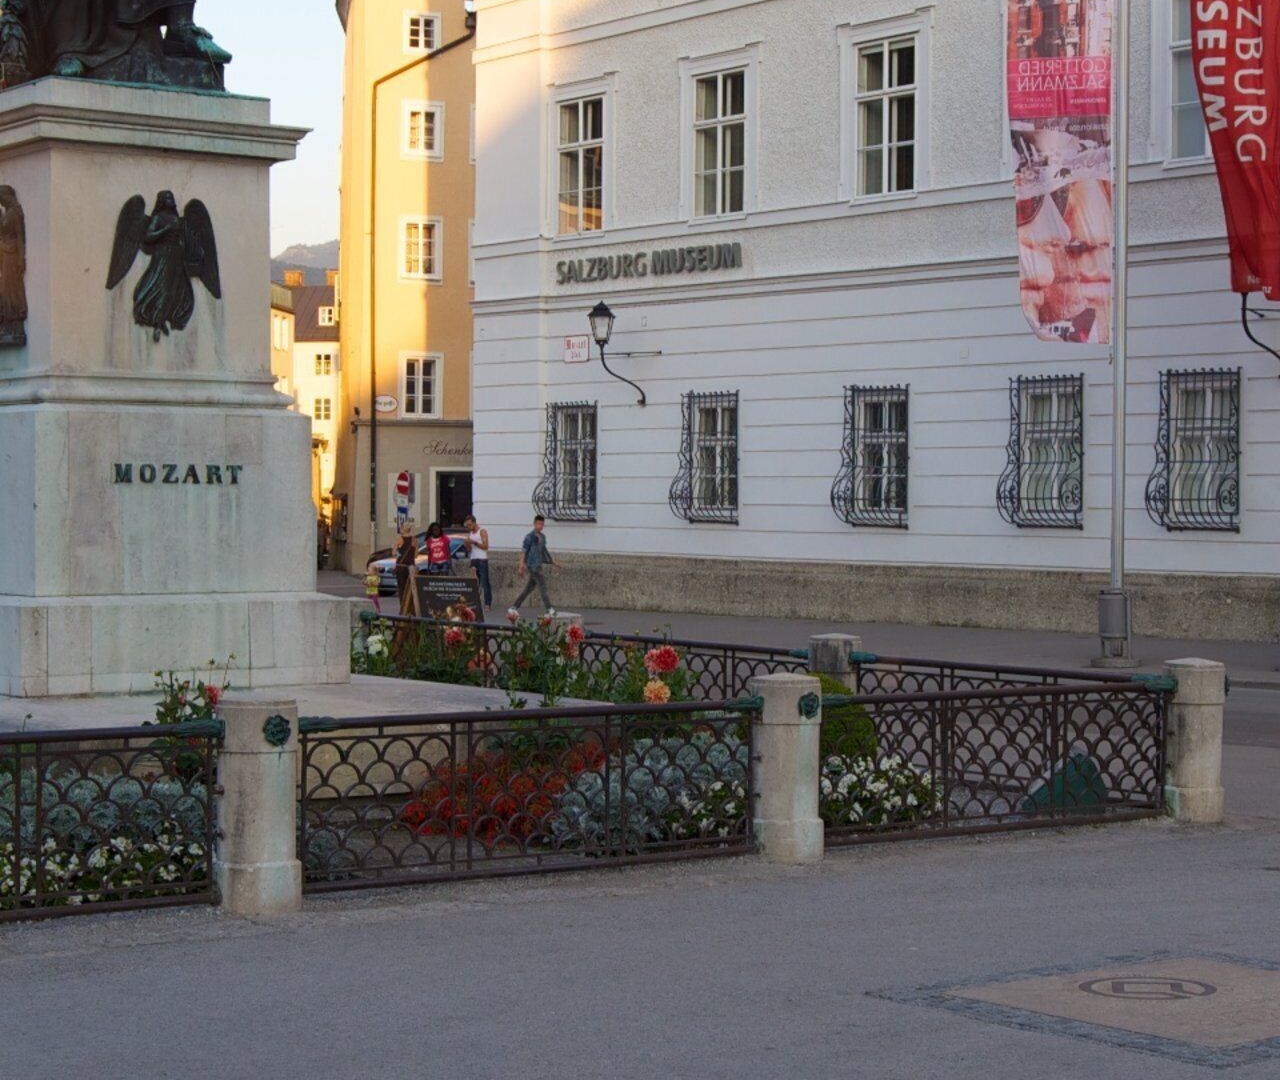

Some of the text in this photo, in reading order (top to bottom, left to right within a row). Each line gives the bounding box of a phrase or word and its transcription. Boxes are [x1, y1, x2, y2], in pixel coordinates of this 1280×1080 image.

[556, 242, 742, 284] SALZBURG MUSEUM
[114, 463, 243, 484] MOZART
